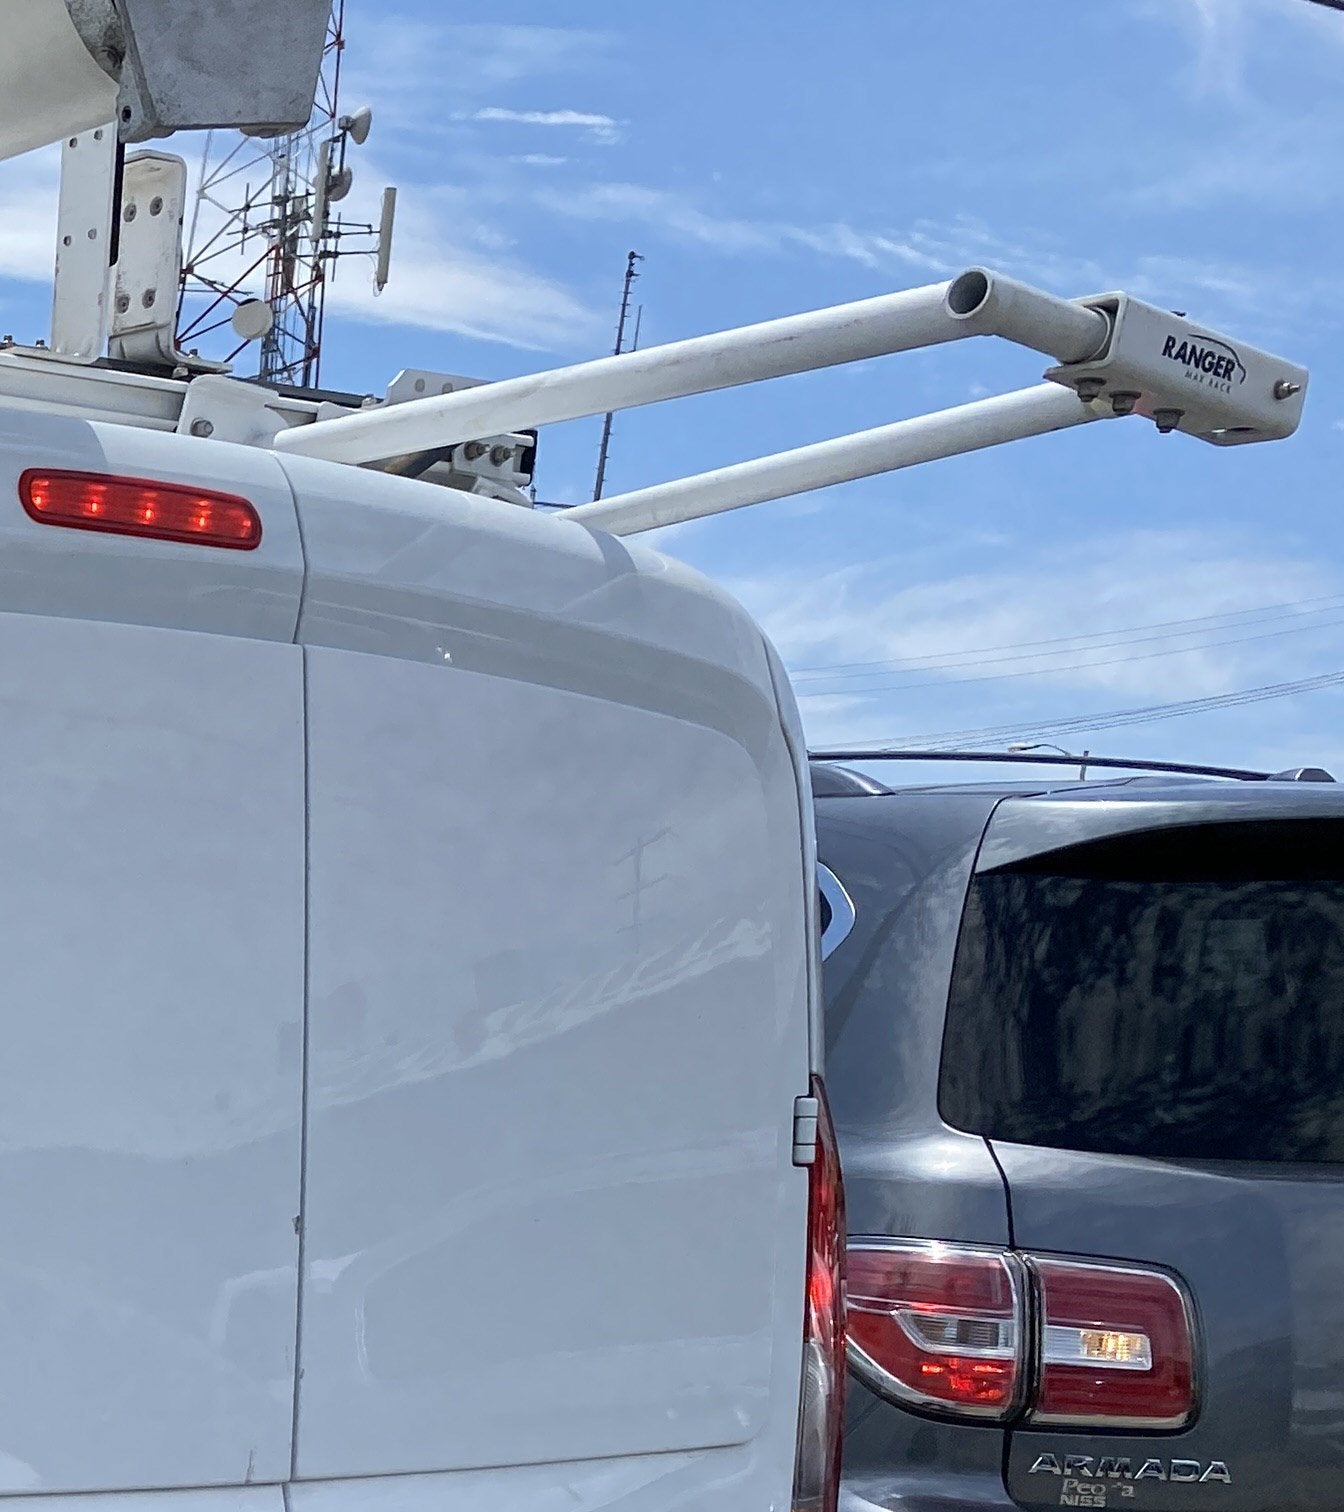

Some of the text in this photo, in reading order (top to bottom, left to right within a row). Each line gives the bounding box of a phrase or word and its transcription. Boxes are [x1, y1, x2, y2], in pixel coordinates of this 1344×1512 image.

[1162, 334, 1236, 382] RANGER
[1184, 370, 1232, 394] MAX RACK
[1027, 1452, 1233, 1485] ARMADA
